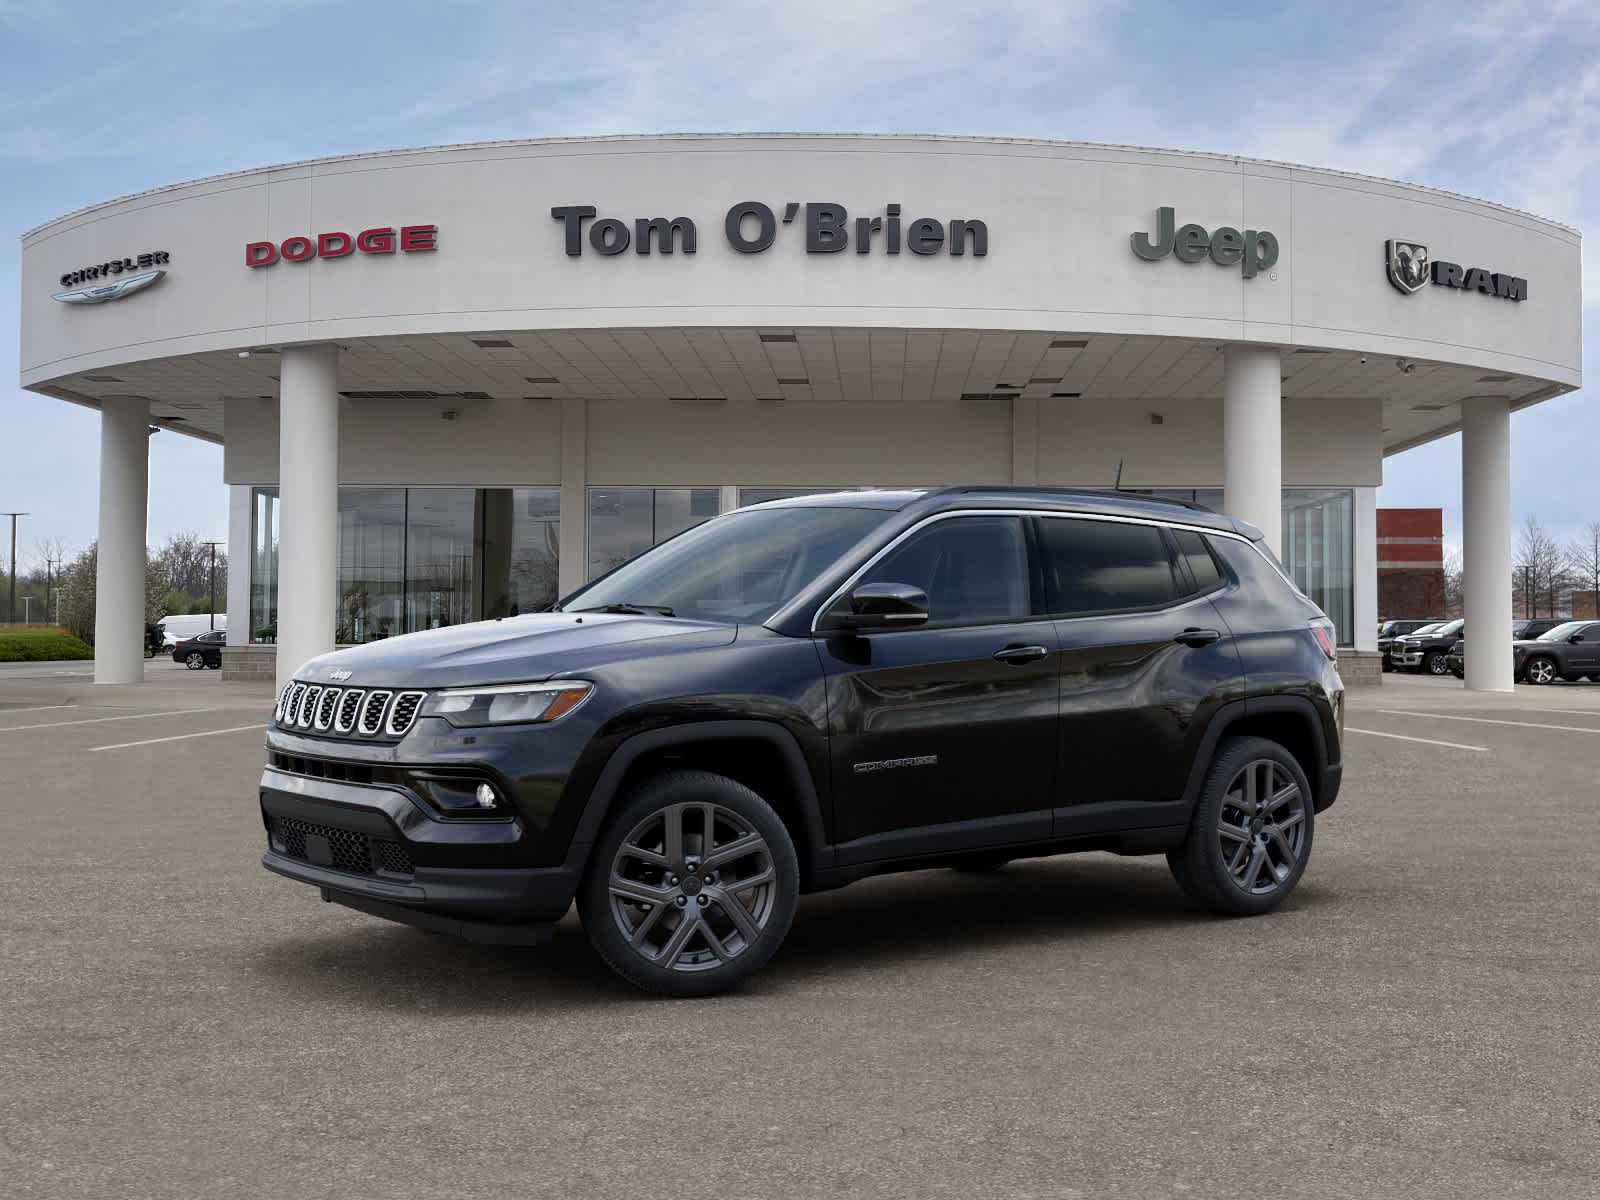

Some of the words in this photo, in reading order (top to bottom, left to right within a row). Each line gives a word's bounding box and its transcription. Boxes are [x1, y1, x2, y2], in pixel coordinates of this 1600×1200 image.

[245, 225, 439, 269] DODGE
[551, 205, 697, 256] Tom
[725, 201, 988, 256] O'Brien
[1131, 206, 1279, 279] Jeep
[60, 250, 170, 287] CHRYSLER
[1430, 260, 1528, 301] RAM
